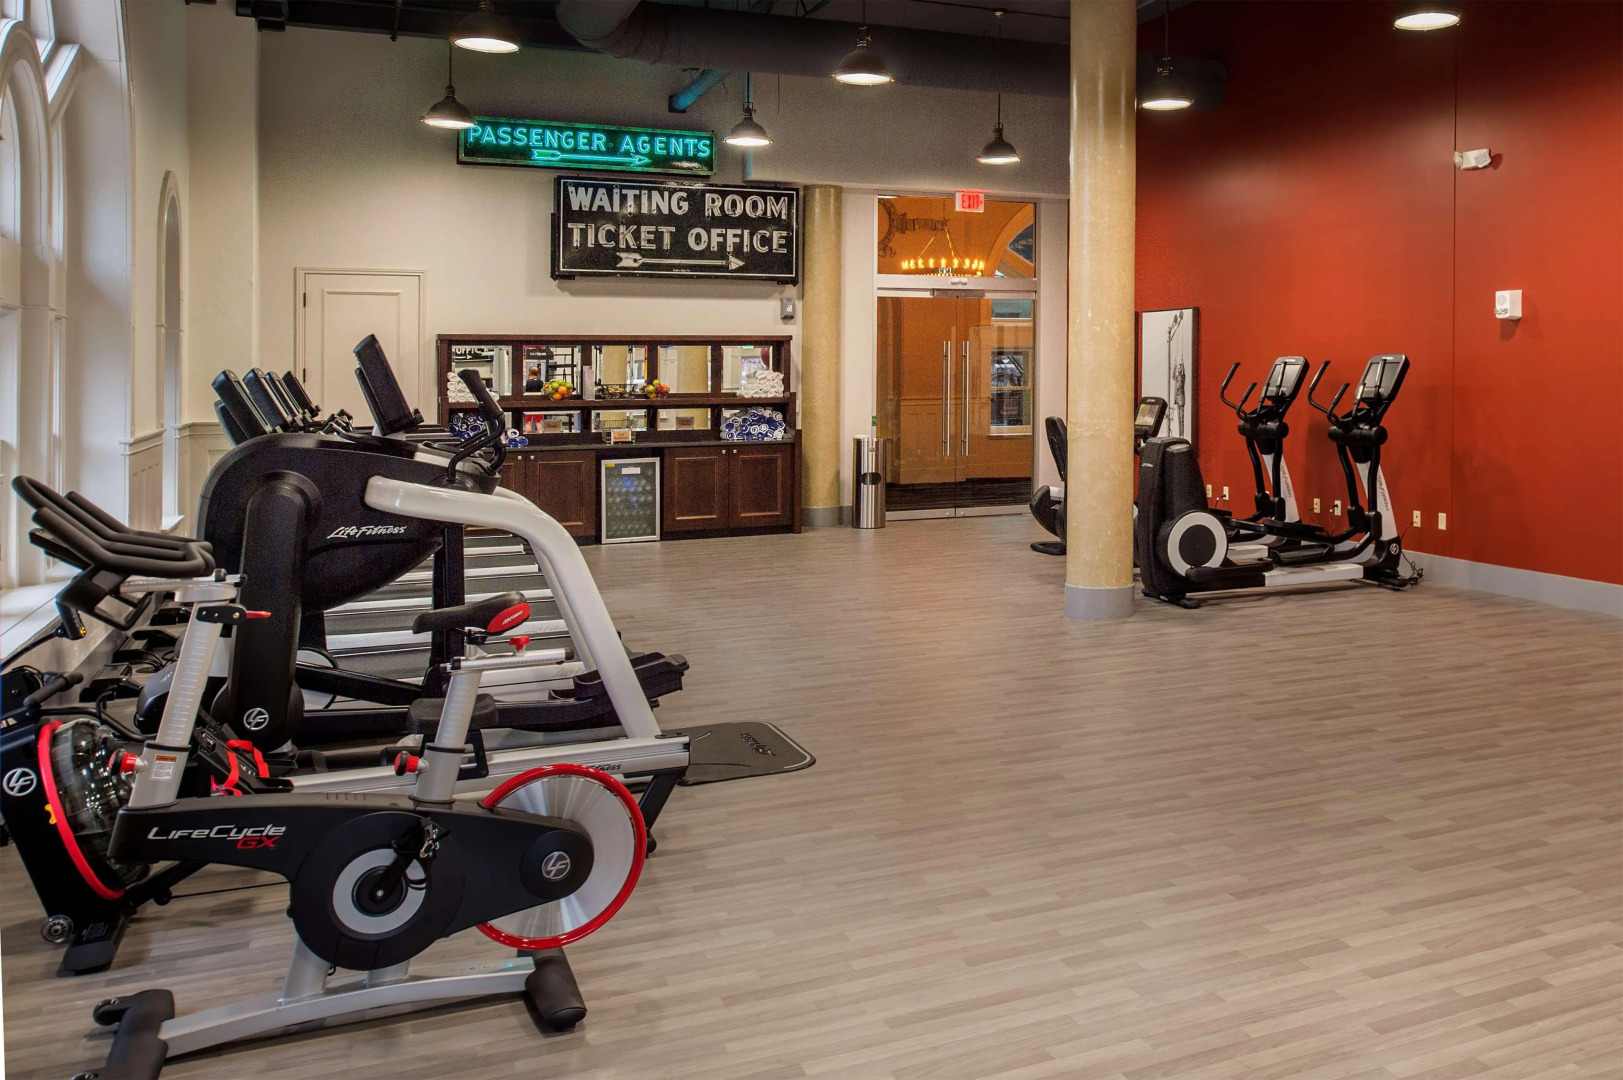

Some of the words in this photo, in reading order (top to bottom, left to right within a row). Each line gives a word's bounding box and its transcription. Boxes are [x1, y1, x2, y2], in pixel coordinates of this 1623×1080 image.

[467, 125, 607, 151] PASSENGER
[619, 134, 711, 158] AGENTS
[567, 186, 689, 215] WAITING
[705, 193, 789, 220] ROOM
[961, 193, 980, 210] EXIT
[567, 223, 676, 250] TICKET
[687, 228, 788, 254] OFFICE
[236, 835, 281, 850] GX
